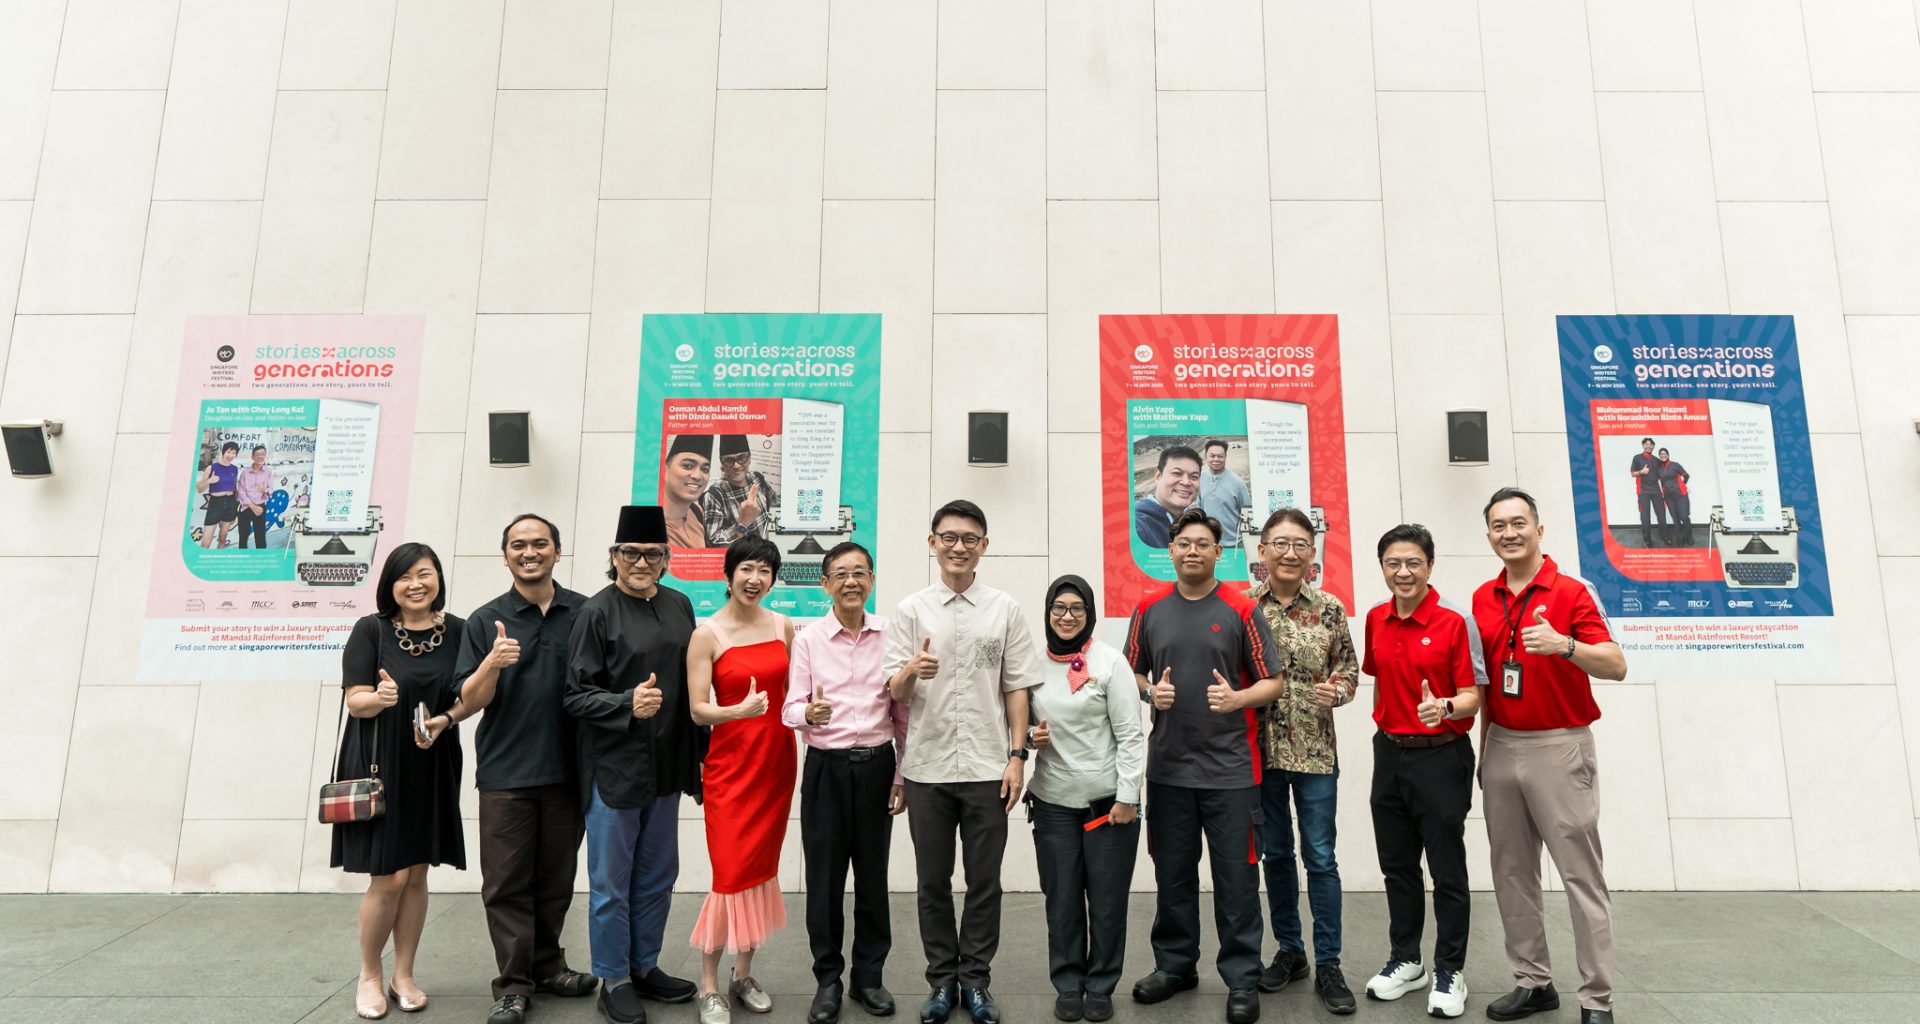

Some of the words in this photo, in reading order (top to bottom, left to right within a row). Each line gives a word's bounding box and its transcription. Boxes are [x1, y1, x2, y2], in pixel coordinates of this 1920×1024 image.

[256, 344, 320, 358] stories
[337, 346, 396, 358] across
[714, 343, 780, 358] stories
[796, 346, 855, 358] across
[1173, 344, 1238, 358] stories
[1255, 346, 1314, 358] across
[1633, 344, 1697, 359] stories
[1714, 347, 1773, 359] across
[254, 360, 394, 380] generations
[714, 359, 855, 380] generations
[1174, 360, 1315, 381] generations
[1634, 360, 1775, 381] generations
[217, 432, 262, 441] COMFORT
[287, 625, 312, 633] luxury
[1729, 624, 1754, 633] luxury
[1756, 624, 1798, 633] staycation
[239, 643, 346, 652] singaporewritersfestival.c
[1685, 643, 1804, 652] singaporewritersfestival.com
